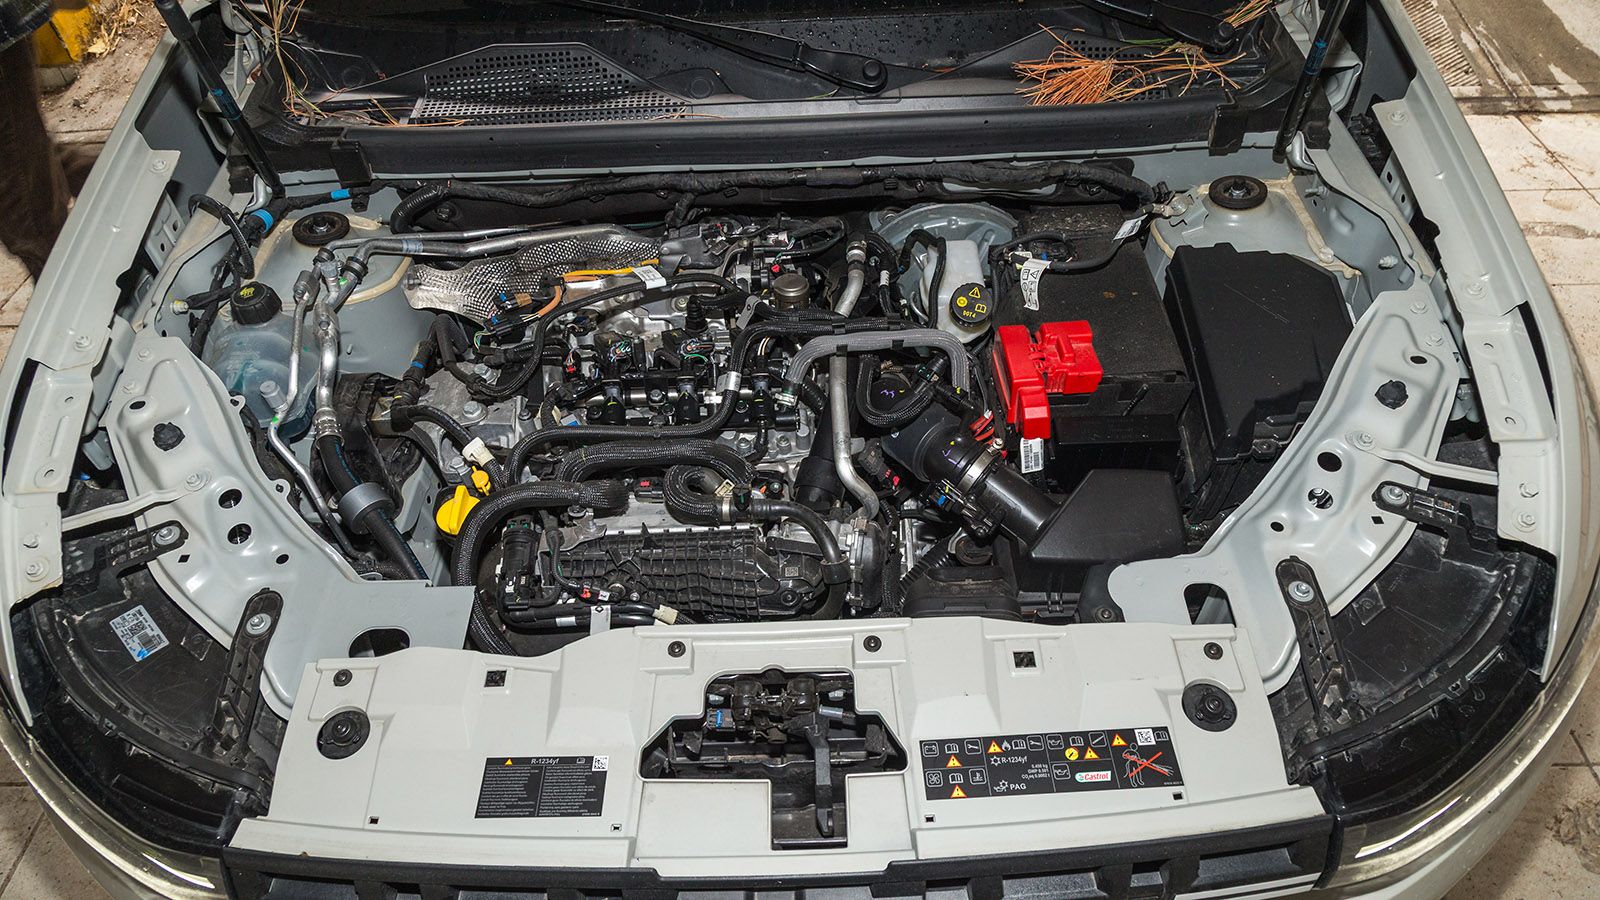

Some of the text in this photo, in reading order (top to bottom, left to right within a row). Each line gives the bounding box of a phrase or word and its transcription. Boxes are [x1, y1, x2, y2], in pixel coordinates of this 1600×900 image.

[530, 758, 560, 766] R-1234yf
[1001, 756, 1028, 764] R-1234yf
[1084, 772, 1109, 780] Castrol
